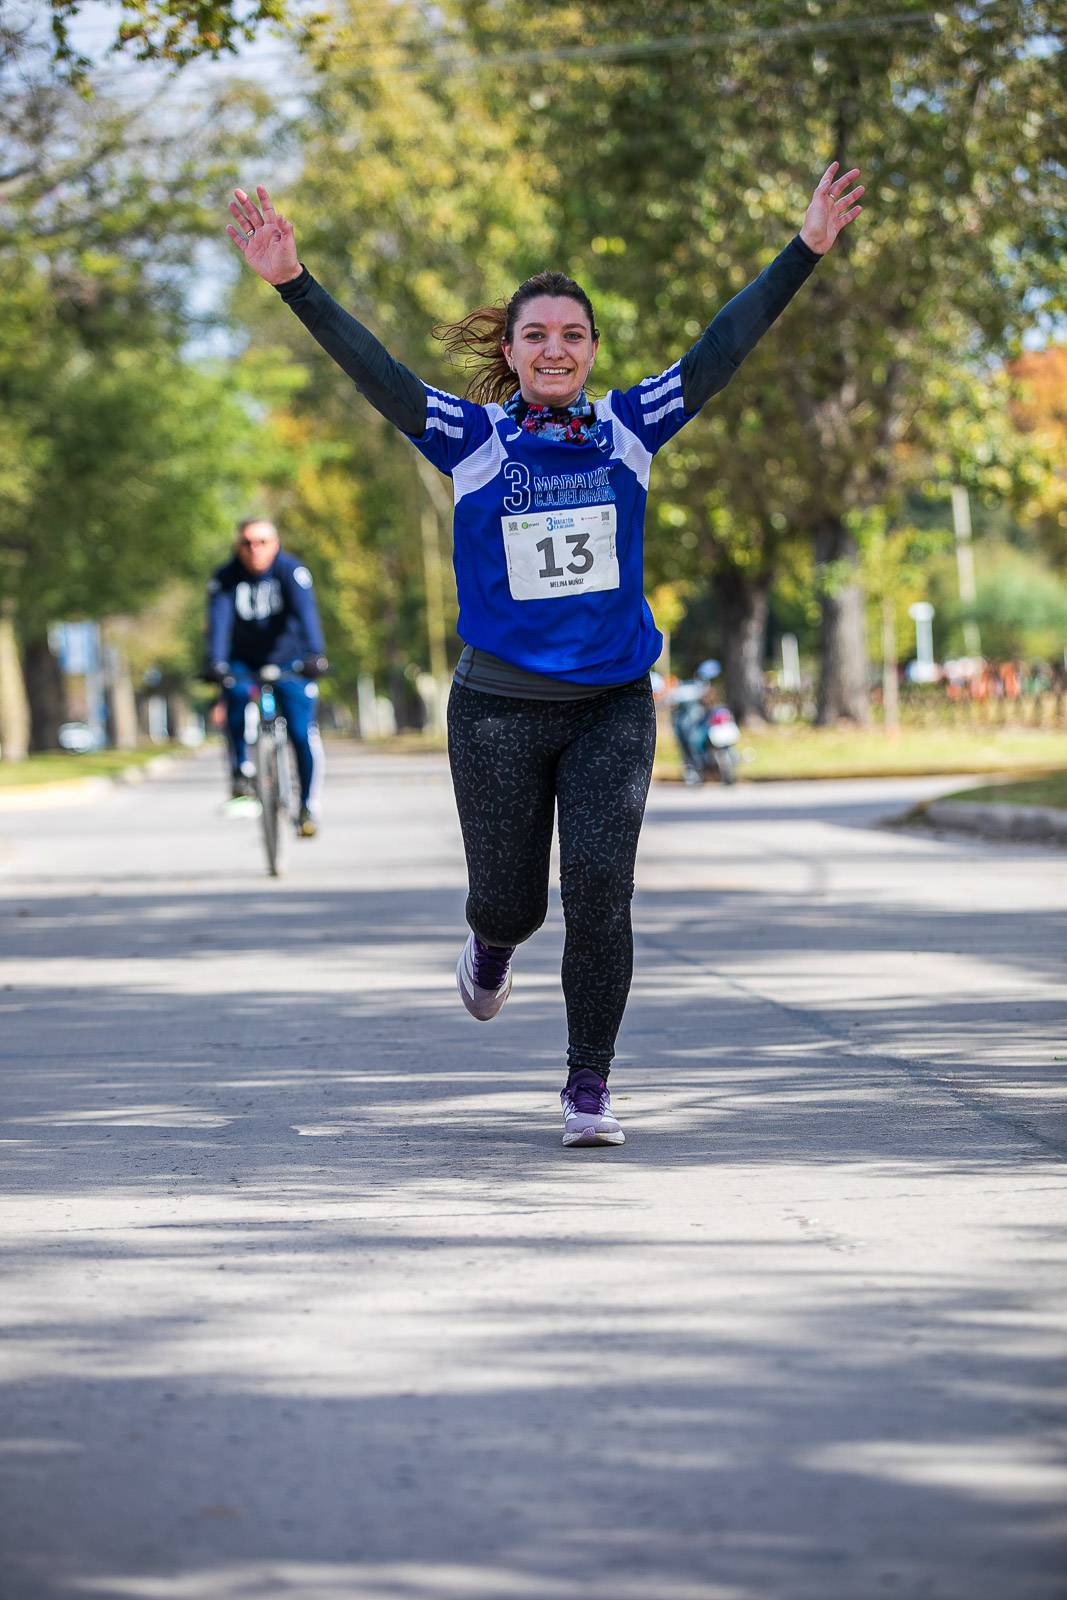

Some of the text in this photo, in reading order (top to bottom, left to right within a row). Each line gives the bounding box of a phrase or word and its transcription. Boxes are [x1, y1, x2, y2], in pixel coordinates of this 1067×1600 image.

[503, 461, 531, 514] 3
[546, 517, 554, 532] 3
[535, 532, 595, 579] 13
[549, 578, 584, 588] MELINA MUÑOZ
